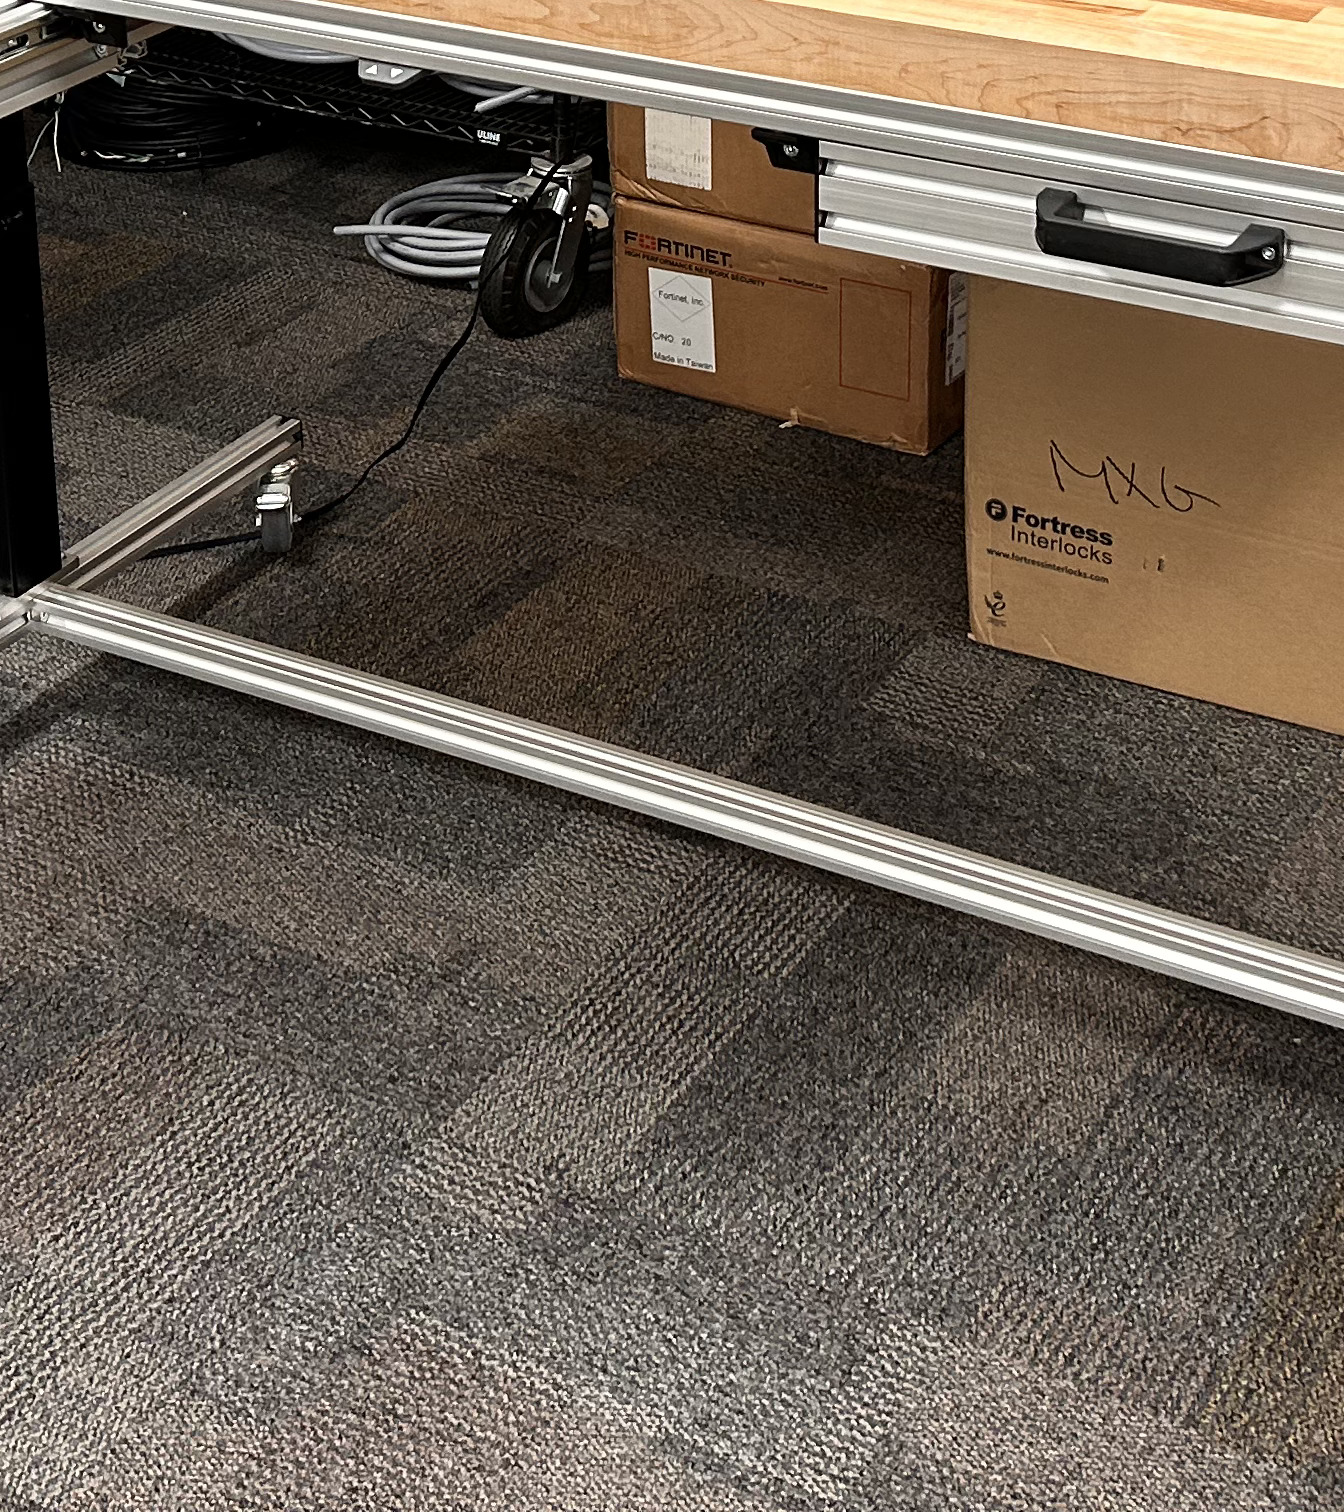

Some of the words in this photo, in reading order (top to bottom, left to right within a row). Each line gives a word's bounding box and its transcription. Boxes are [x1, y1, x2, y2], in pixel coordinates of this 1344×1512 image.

[623, 230, 732, 267] FORTINET
[731, 274, 766, 287] SECURITY
[654, 352, 676, 363] Made
[677, 355, 685, 364] in
[1012, 505, 1113, 547] Fortress
[1011, 525, 1113, 565] Interlocks
[986, 546, 1110, 584] www.fortressinterlocks.com
